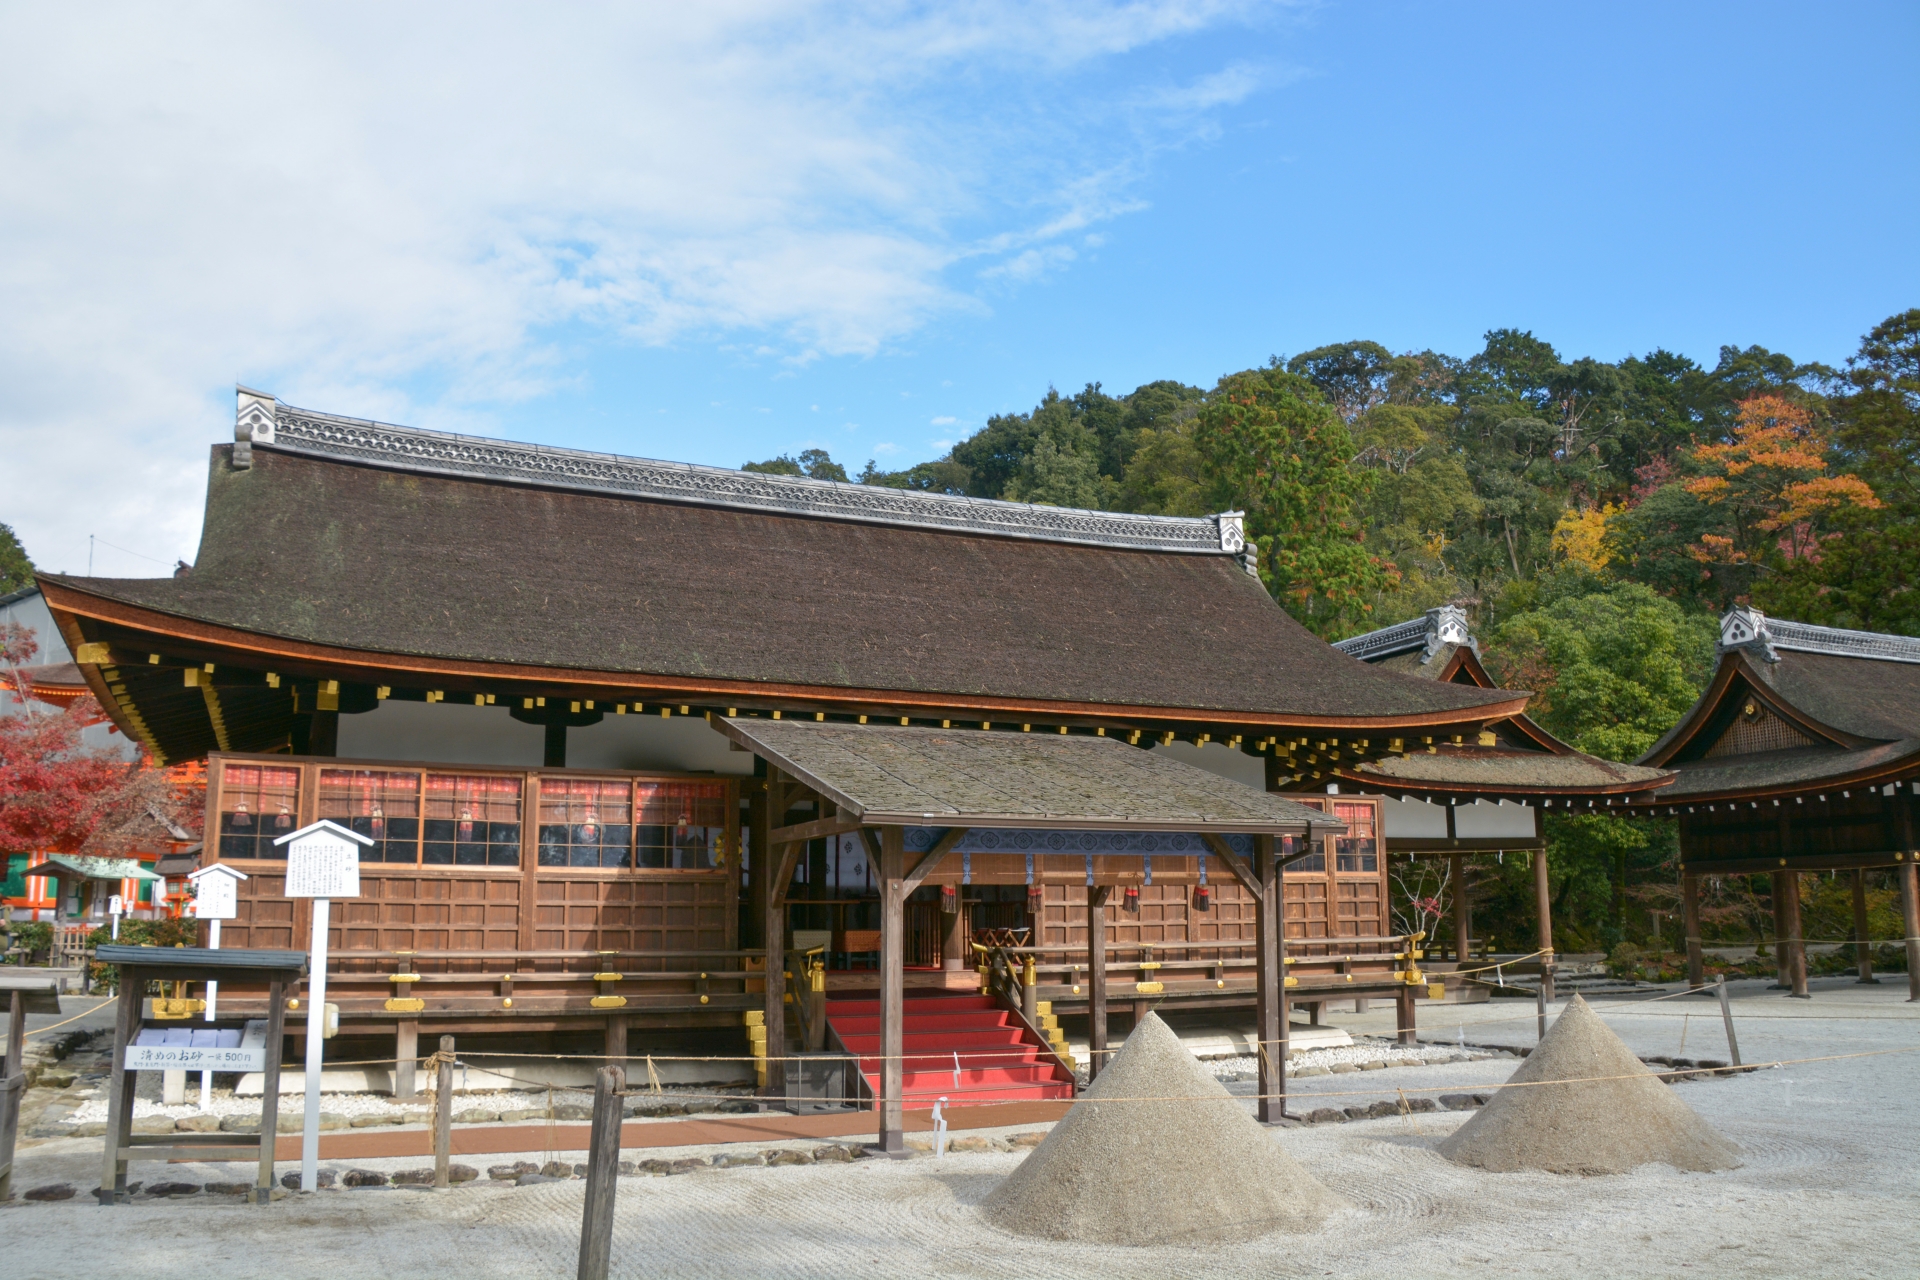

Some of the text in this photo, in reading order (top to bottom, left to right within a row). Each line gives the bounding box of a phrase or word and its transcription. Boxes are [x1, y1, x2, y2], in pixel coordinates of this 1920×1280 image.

[141, 1049, 204, 1062] 清めのお砂
[225, 1052, 251, 1062] 500円
